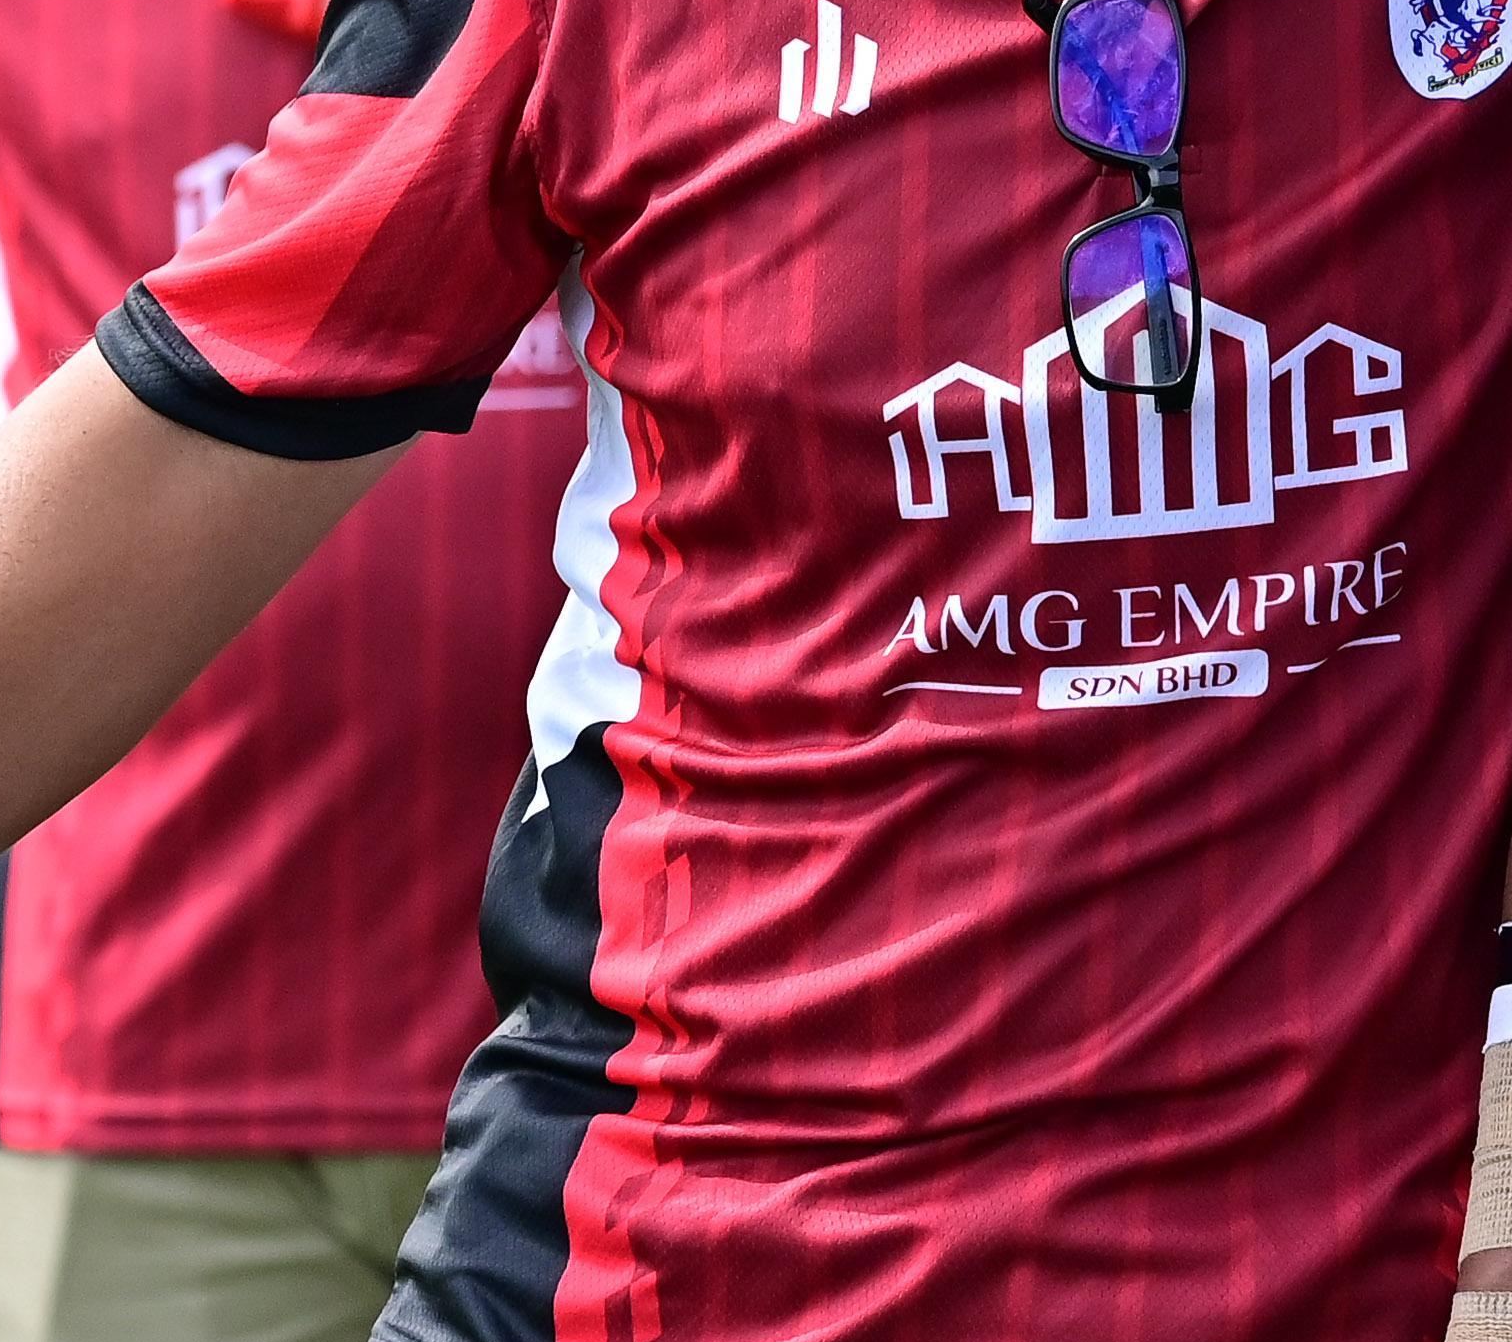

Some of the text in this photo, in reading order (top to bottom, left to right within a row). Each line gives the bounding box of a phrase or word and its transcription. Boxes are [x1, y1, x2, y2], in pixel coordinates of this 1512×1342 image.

[884, 544, 1407, 657] AMG EMPIRE
[1067, 661, 1238, 701] SDN BHD
